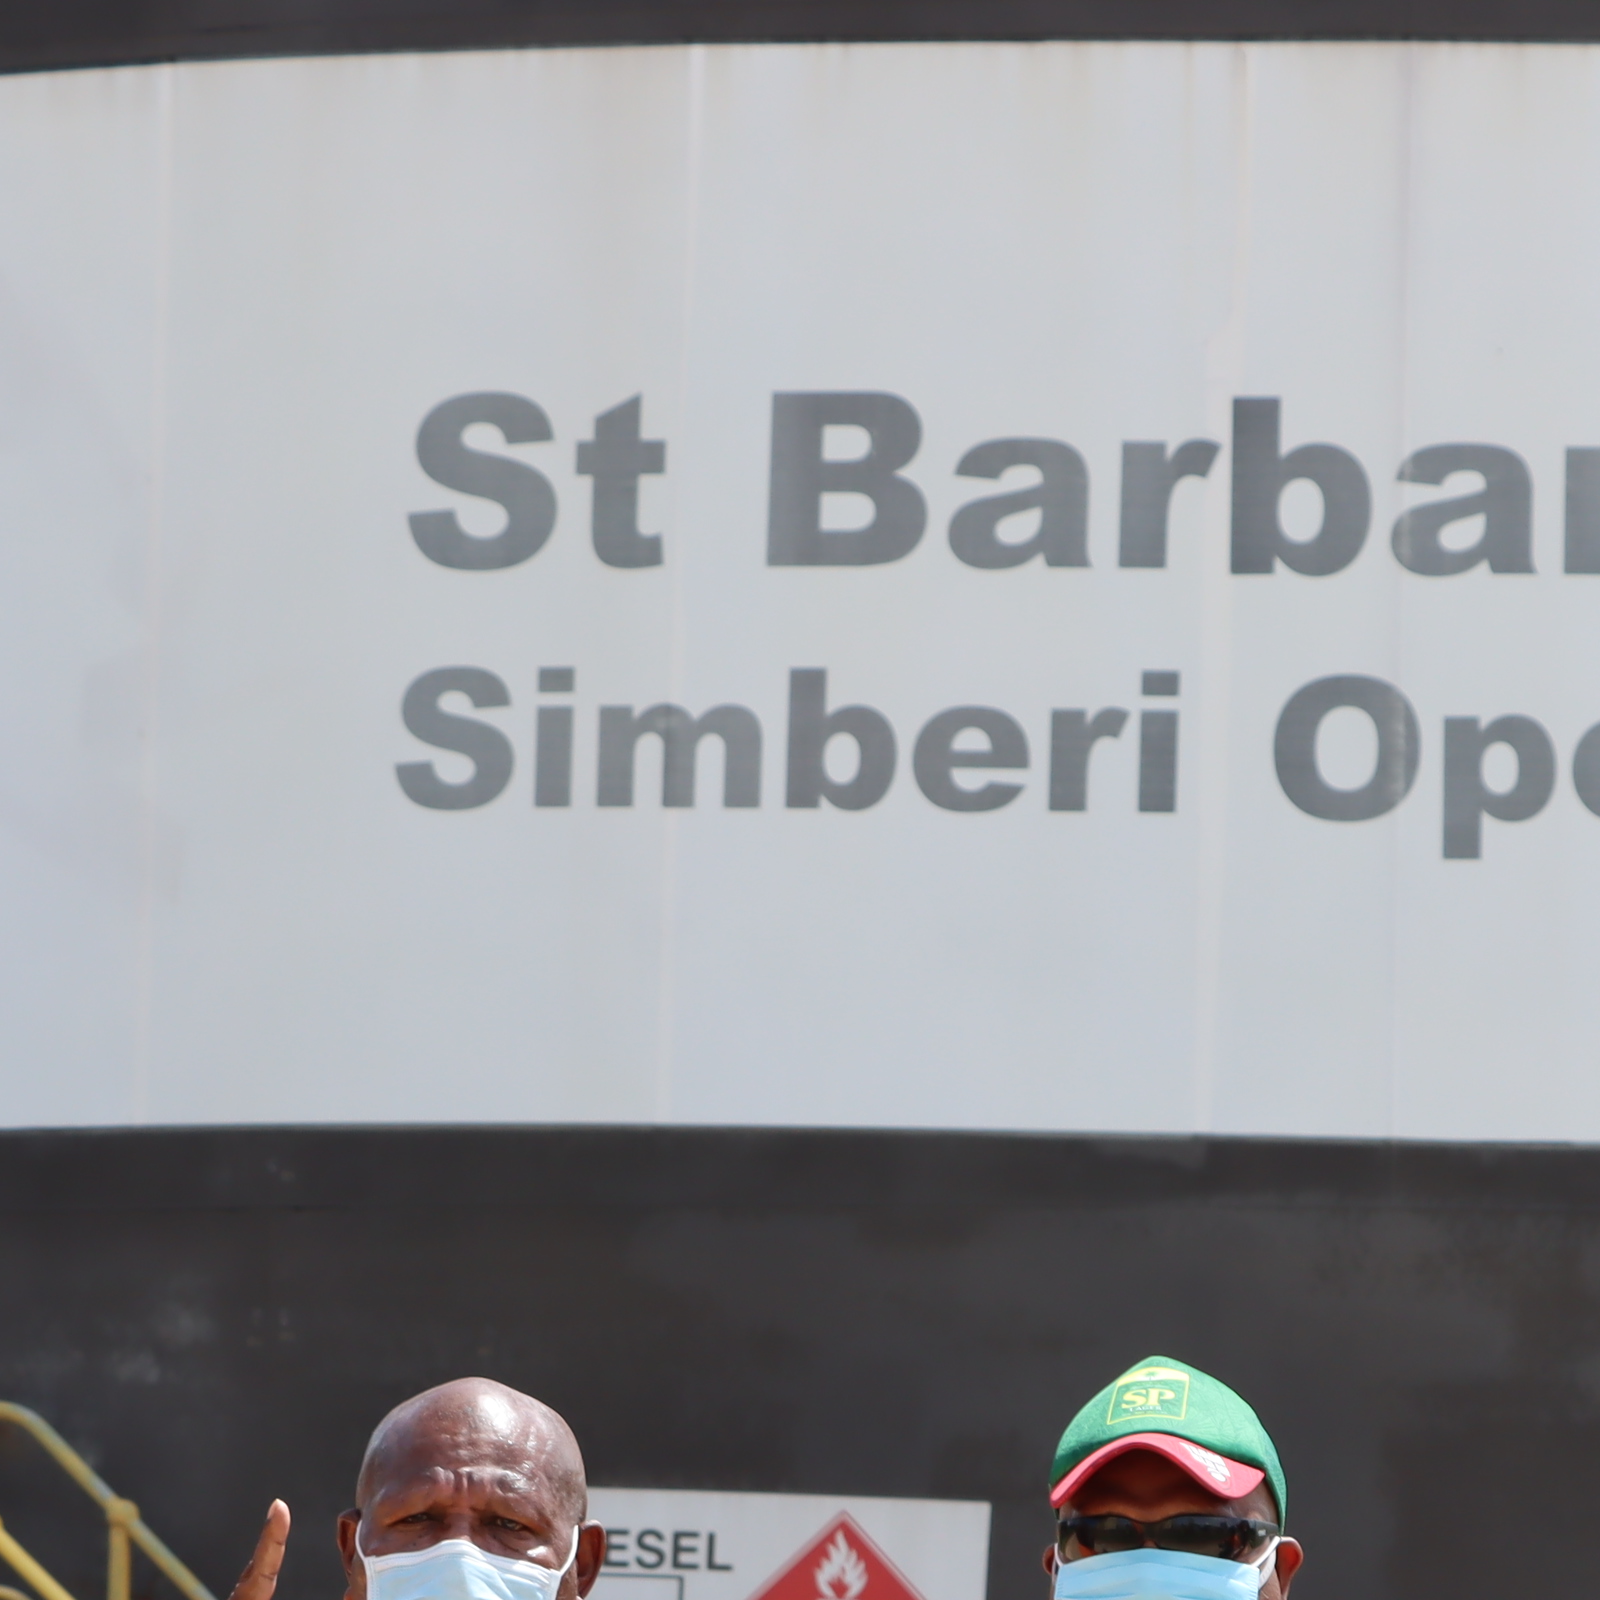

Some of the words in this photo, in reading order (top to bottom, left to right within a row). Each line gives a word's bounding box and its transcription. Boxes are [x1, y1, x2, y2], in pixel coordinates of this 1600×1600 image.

[406, 390, 668, 573] St
[393, 664, 1182, 815] Simberi
[1122, 1388, 1176, 1409] SP
[604, 1529, 733, 1571] ESEL
